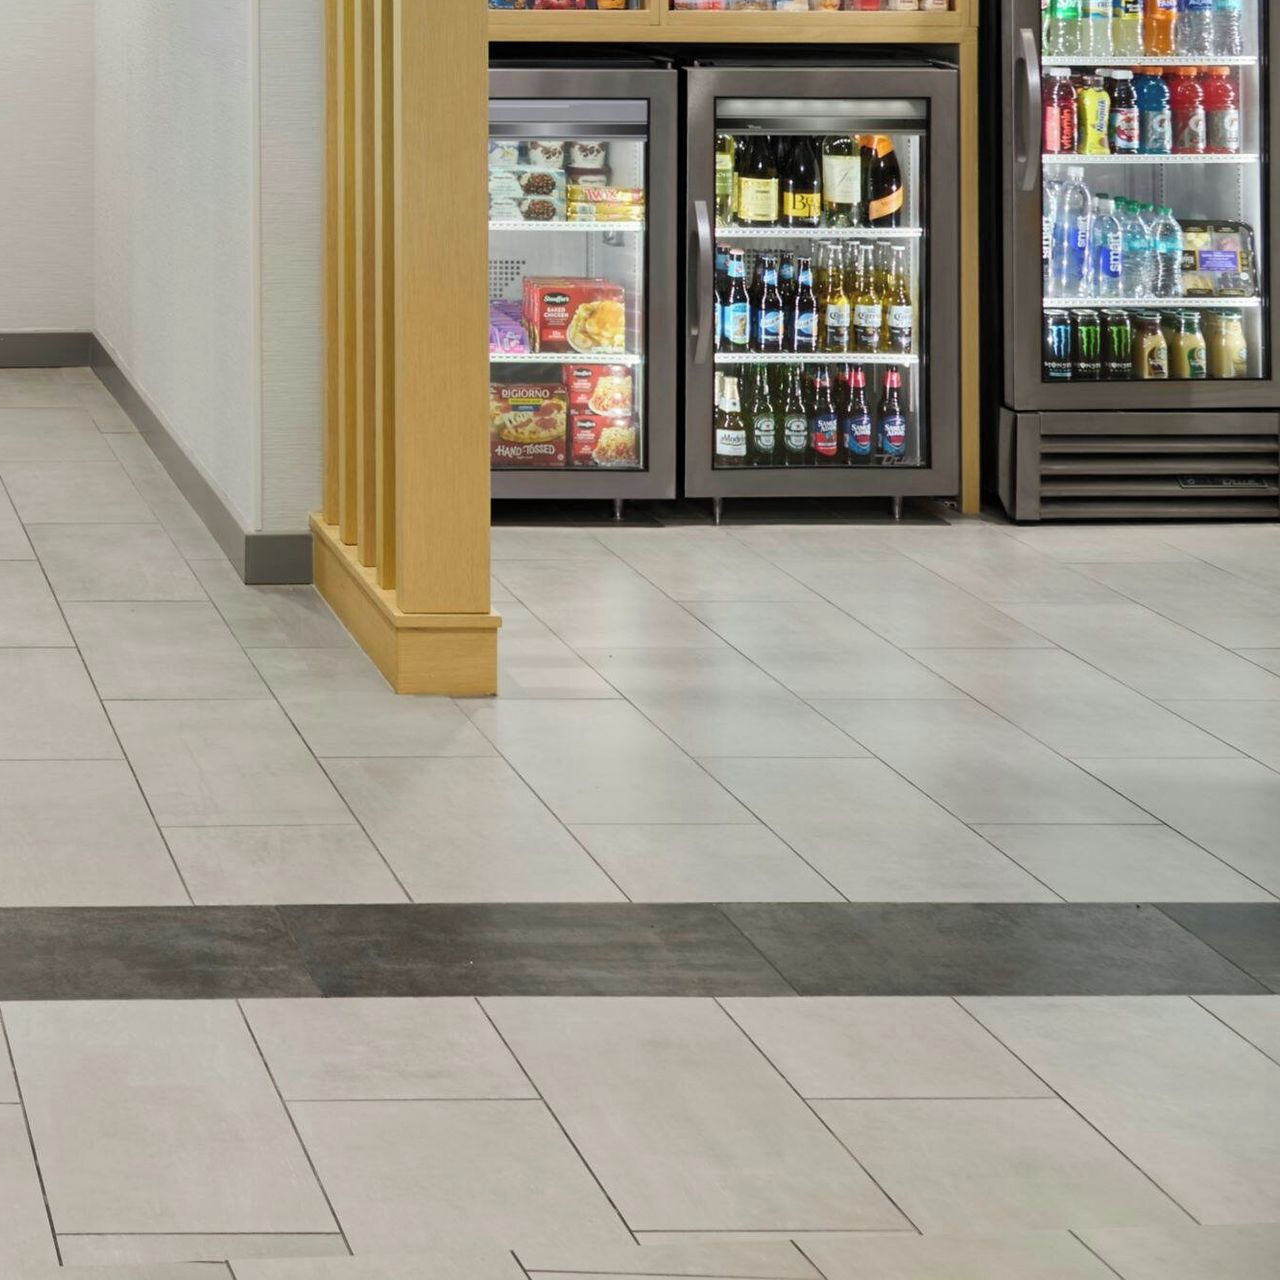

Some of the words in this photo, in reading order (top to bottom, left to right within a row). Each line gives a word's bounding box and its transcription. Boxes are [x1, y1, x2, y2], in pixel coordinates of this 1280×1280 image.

[1061, 109, 1072, 149] vitamin
[1078, 217, 1087, 248] smart
[1110, 232, 1120, 272] smart
